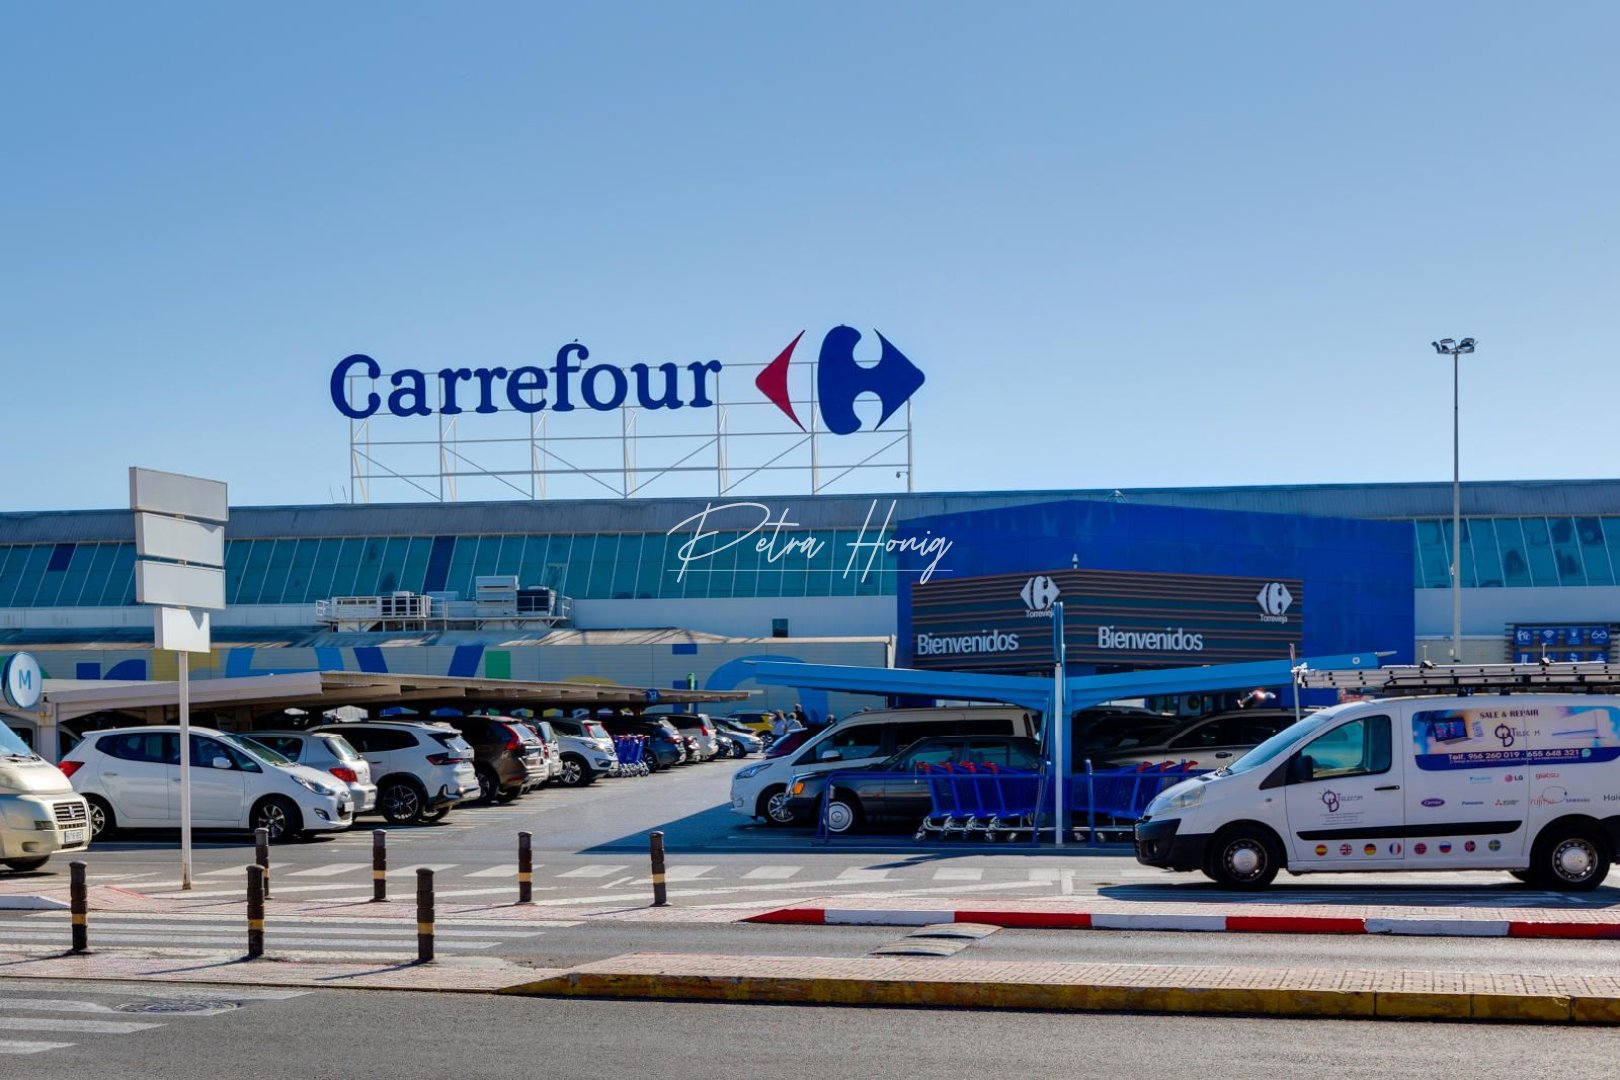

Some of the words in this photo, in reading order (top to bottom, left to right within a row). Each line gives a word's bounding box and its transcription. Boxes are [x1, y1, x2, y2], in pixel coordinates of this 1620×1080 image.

[330, 342, 722, 419] Carrefour
[1025, 608, 1054, 618] Torreviej
[917, 629, 1019, 656] Bienvenidos
[1098, 625, 1203, 651] Bienvenidos
[18, 669, 31, 690] M
[1480, 711, 1498, 719] SALE
[1509, 709, 1539, 718] REPAIR
